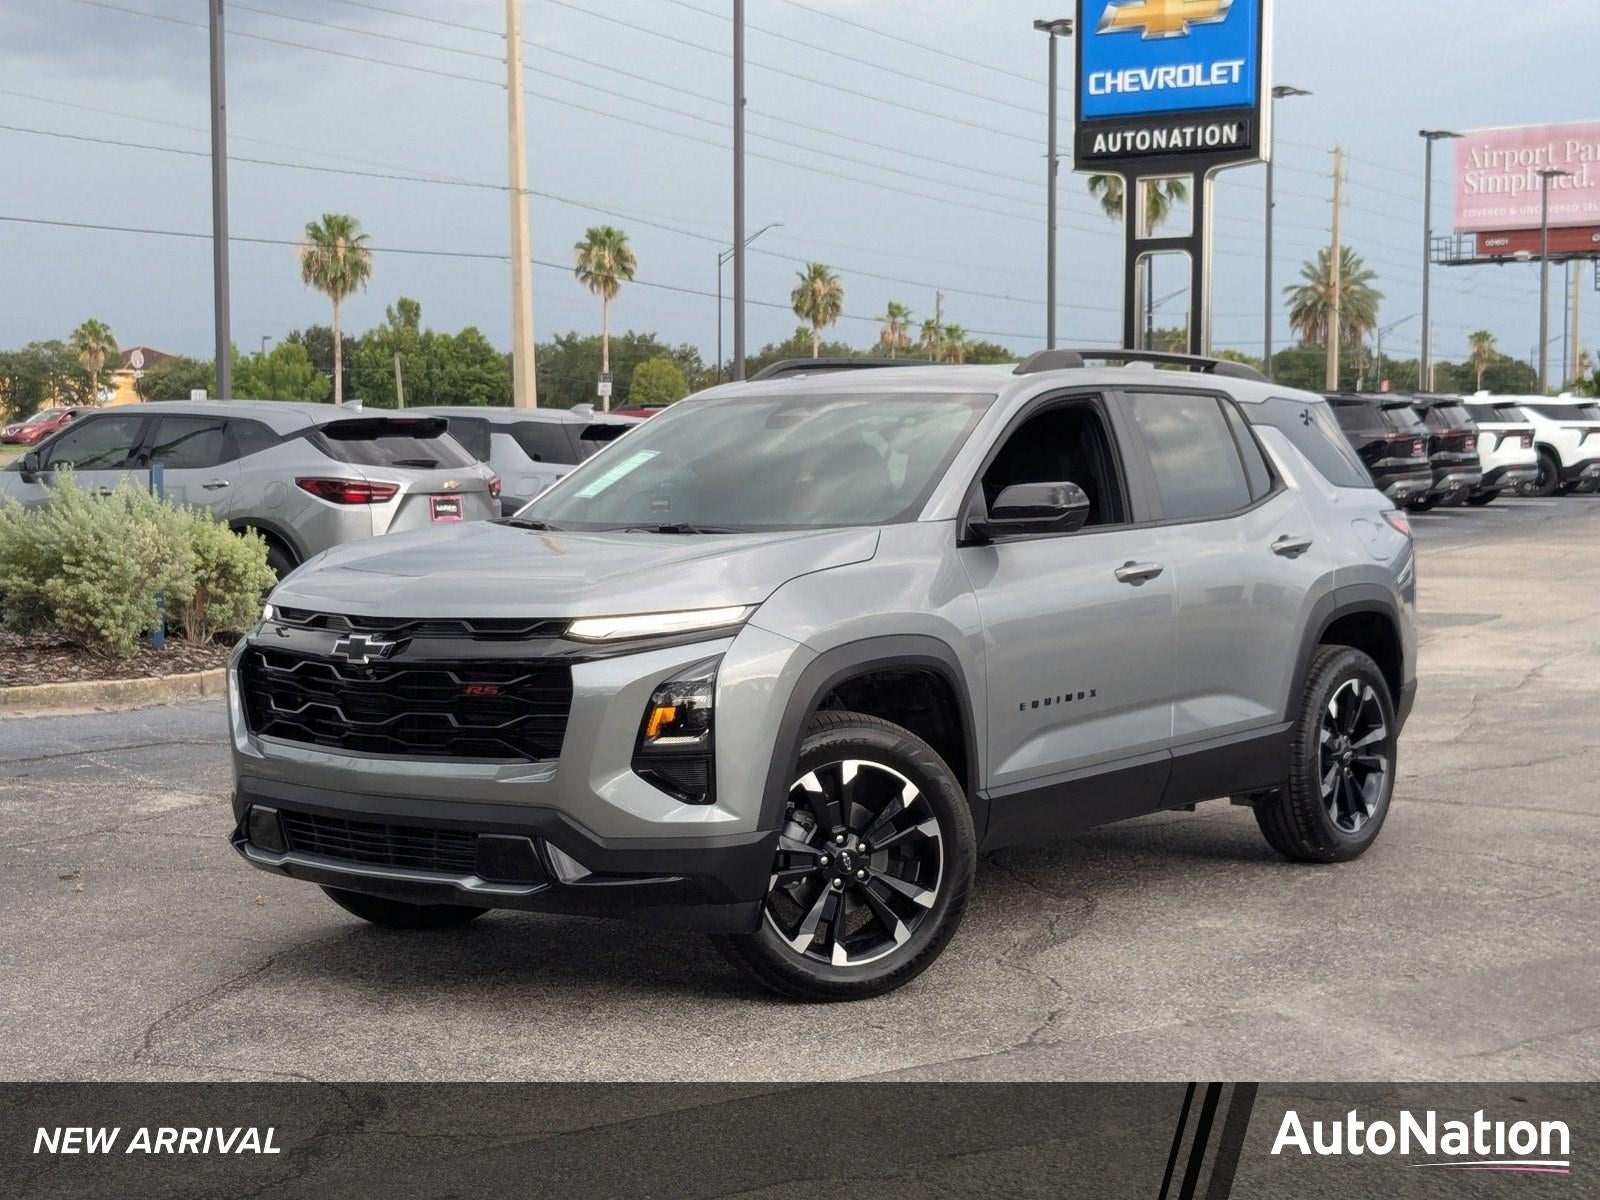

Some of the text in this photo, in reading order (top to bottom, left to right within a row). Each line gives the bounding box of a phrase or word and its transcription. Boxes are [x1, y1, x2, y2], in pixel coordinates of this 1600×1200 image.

[1088, 60, 1245, 95] CHEVROLET
[1093, 123, 1238, 154] AUTONATION
[1464, 144, 1553, 172] Airport
[466, 686, 498, 695] RS
[1019, 688, 1097, 712] EQUINOX
